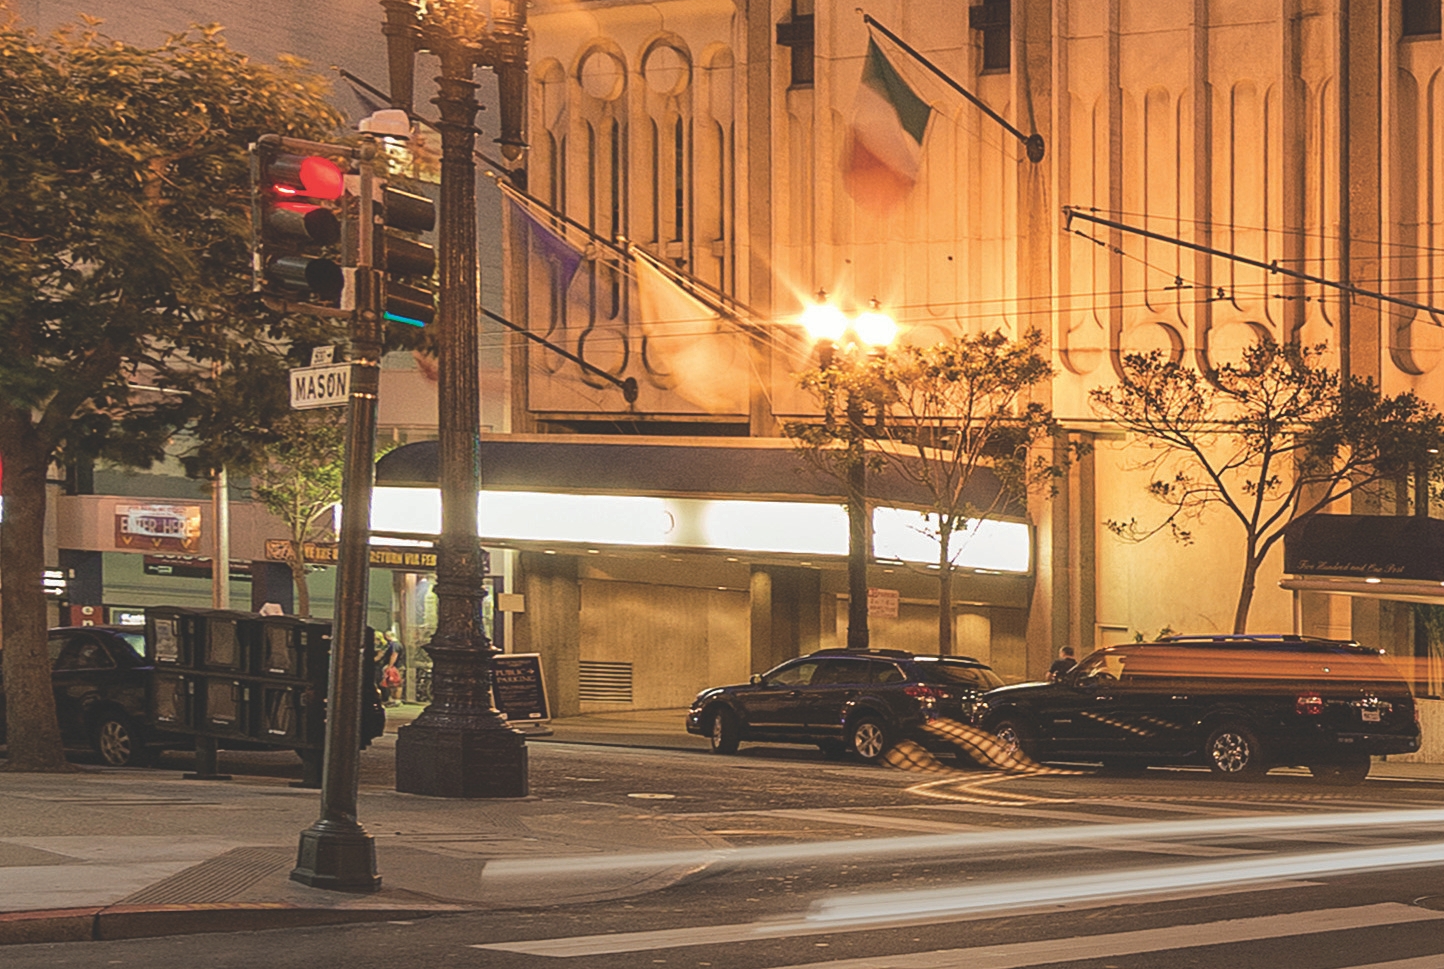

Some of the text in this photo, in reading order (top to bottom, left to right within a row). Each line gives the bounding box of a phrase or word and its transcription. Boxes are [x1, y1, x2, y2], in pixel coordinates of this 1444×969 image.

[295, 372, 347, 402] MASON
[163, 518, 193, 537] HERE
[369, 550, 403, 565] RETURN
[404, 552, 420, 566] VIA
